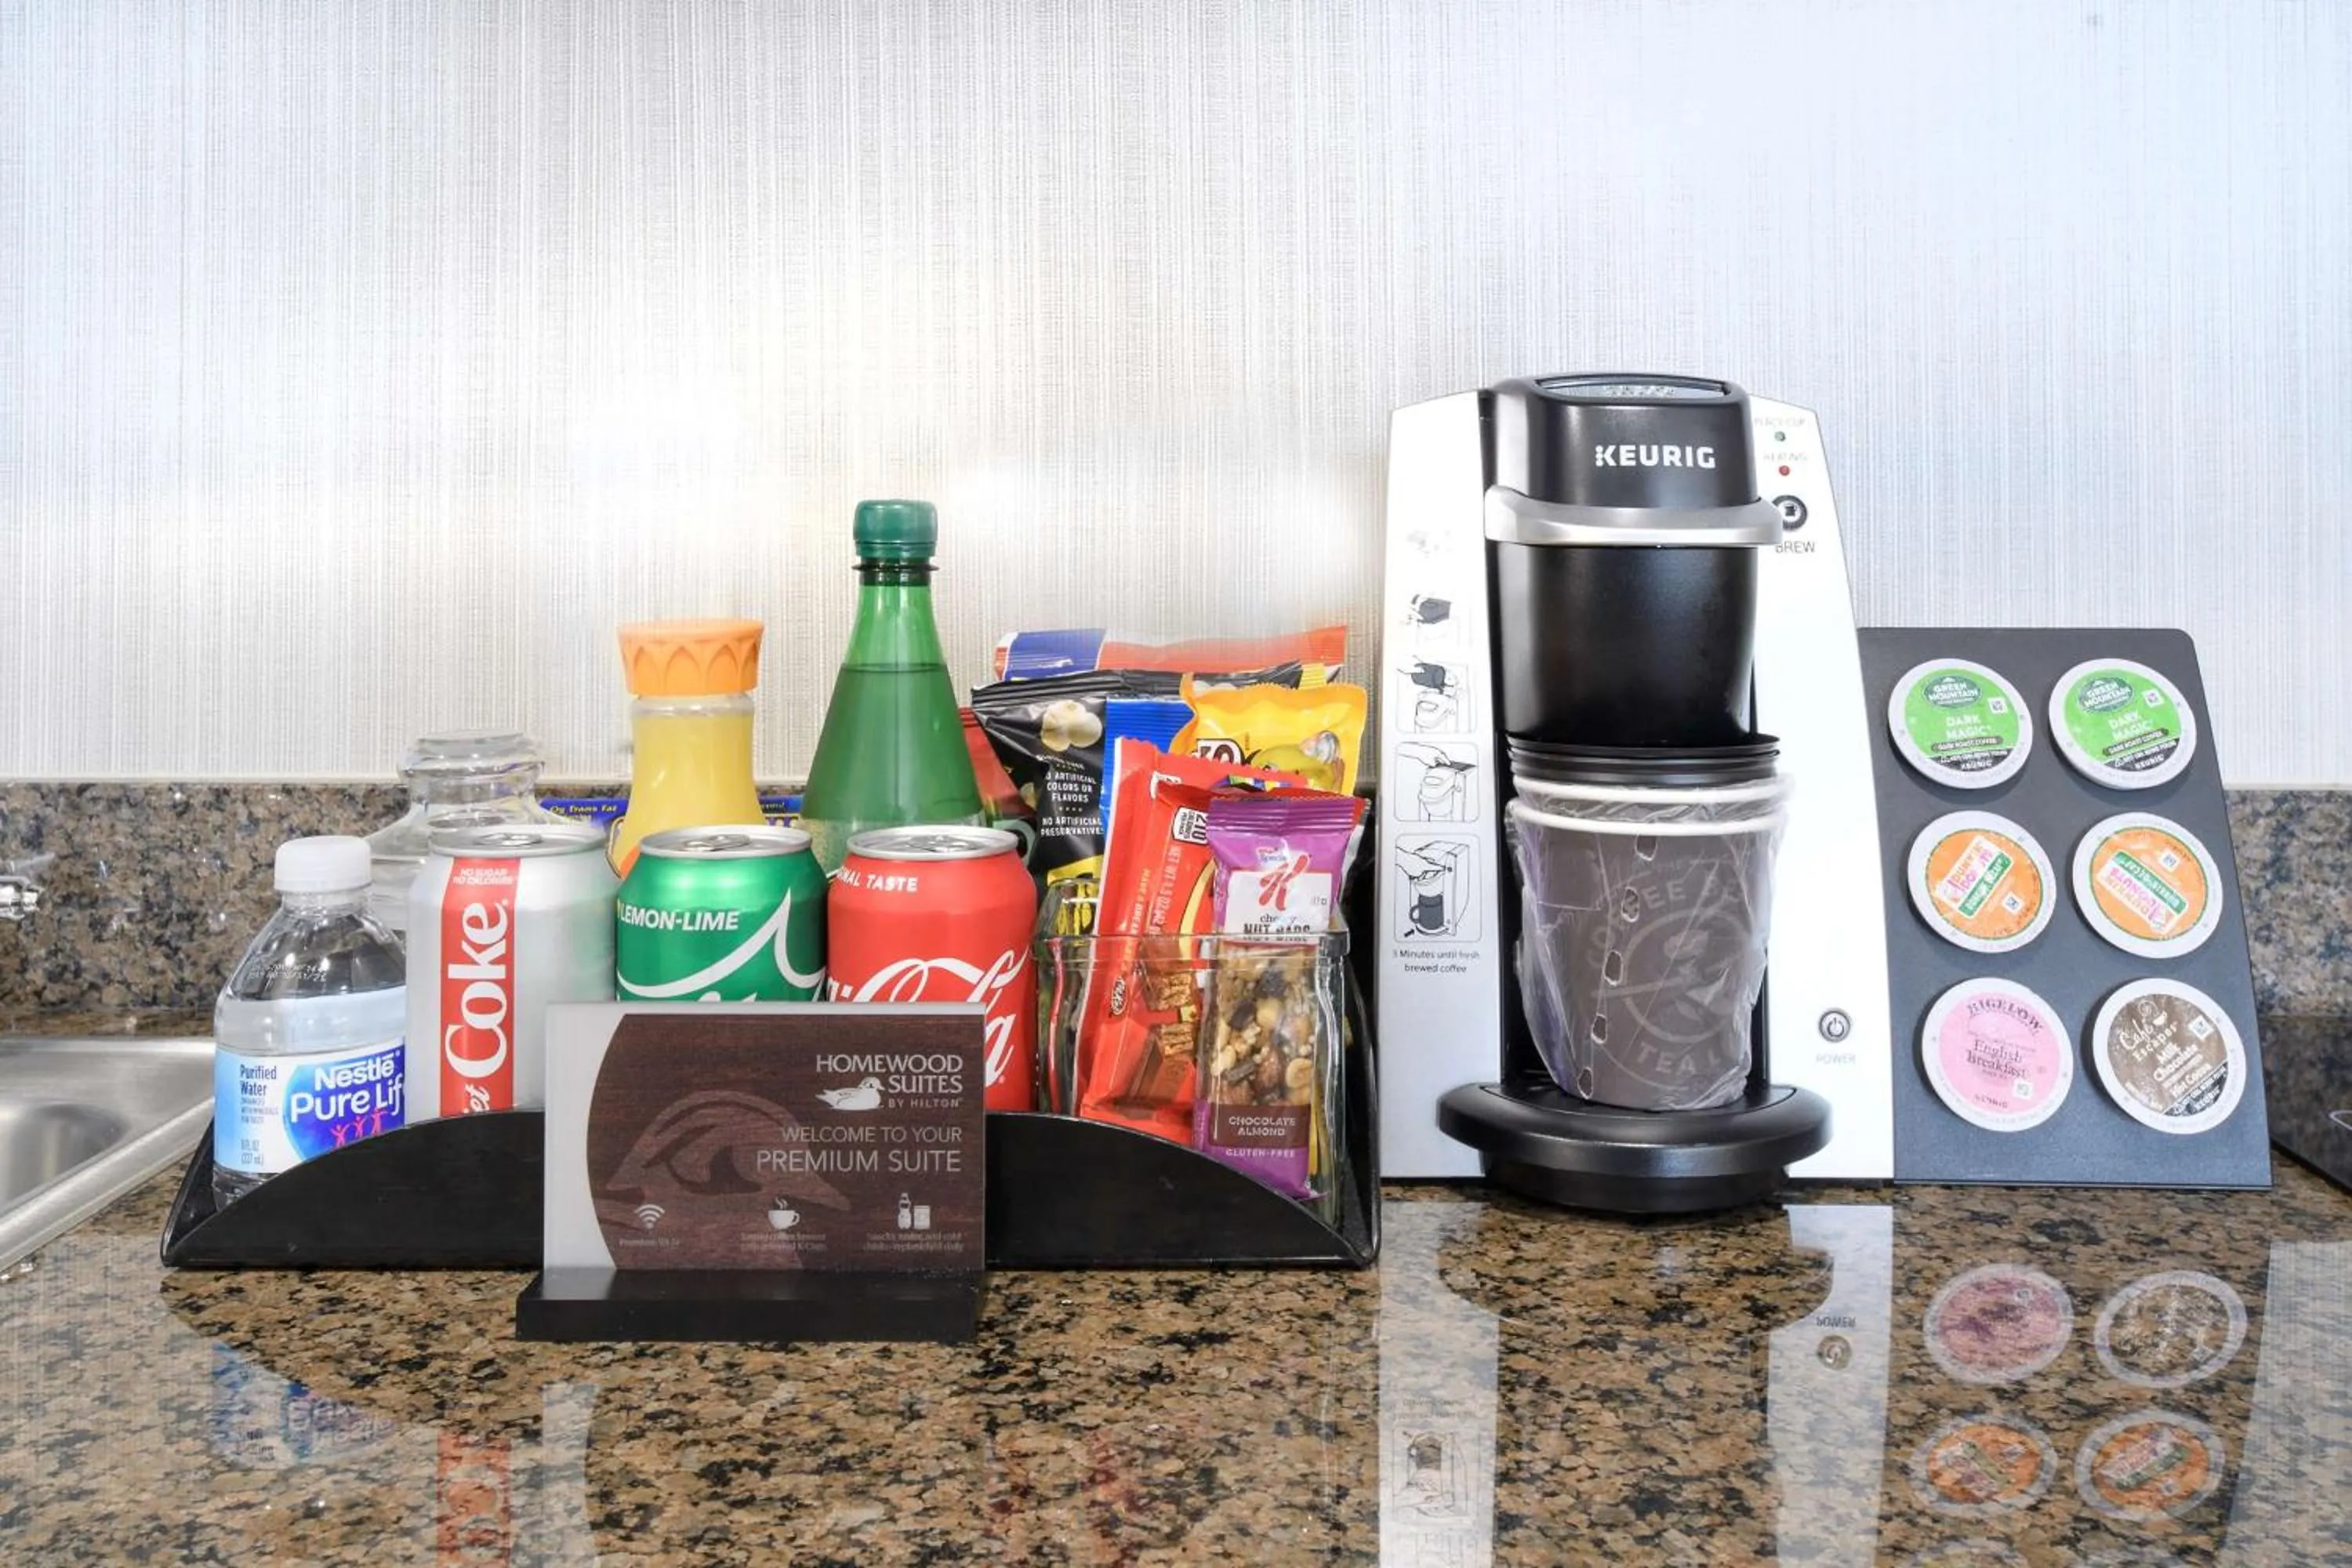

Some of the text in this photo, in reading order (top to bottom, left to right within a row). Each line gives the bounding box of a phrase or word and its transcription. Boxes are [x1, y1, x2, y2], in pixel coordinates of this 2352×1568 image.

[1595, 445, 1716, 469] KEURIG
[1776, 541, 1815, 554] BREW
[1933, 682, 1967, 692] GREEN
[1928, 690, 1978, 701] MOUNTAIN
[1946, 715, 1981, 726] DARK
[1047, 782, 1092, 793] COLORS OR
[1052, 793, 1089, 803] FLAVORS
[1043, 817, 1053, 826] NO
[866, 874, 918, 891] TASTE
[620, 903, 740, 931] LEMON-LIME
[1437, 949, 1457, 957] until
[445, 902, 508, 1079] Coke
[1968, 998, 2043, 1031] BIGELOW
[2132, 1022, 2177, 1061] Escapes
[1638, 1044, 1695, 1075] TEA
[1817, 1054, 1855, 1064] POWER
[1973, 1040, 2022, 1063] English
[815, 1054, 964, 1073] HOMEWOOD
[1965, 1049, 2027, 1079] Breakfast
[240, 1064, 277, 1080] Purified
[240, 1081, 267, 1096] Water
[888, 1075, 963, 1094] SUITES
[291, 1089, 371, 1123] Pure
[376, 1073, 405, 1116] Lif
[888, 1098, 958, 1108] BY HILTON
[1229, 1116, 1296, 1127] CHOCOLATE
[782, 1127, 963, 1143] WELCOME TO YOUR
[1238, 1127, 1286, 1137] ALMOND
[757, 1151, 961, 1172] PREMIUM SUITE
[1225, 1149, 1295, 1158] GLUTEN-FREE
